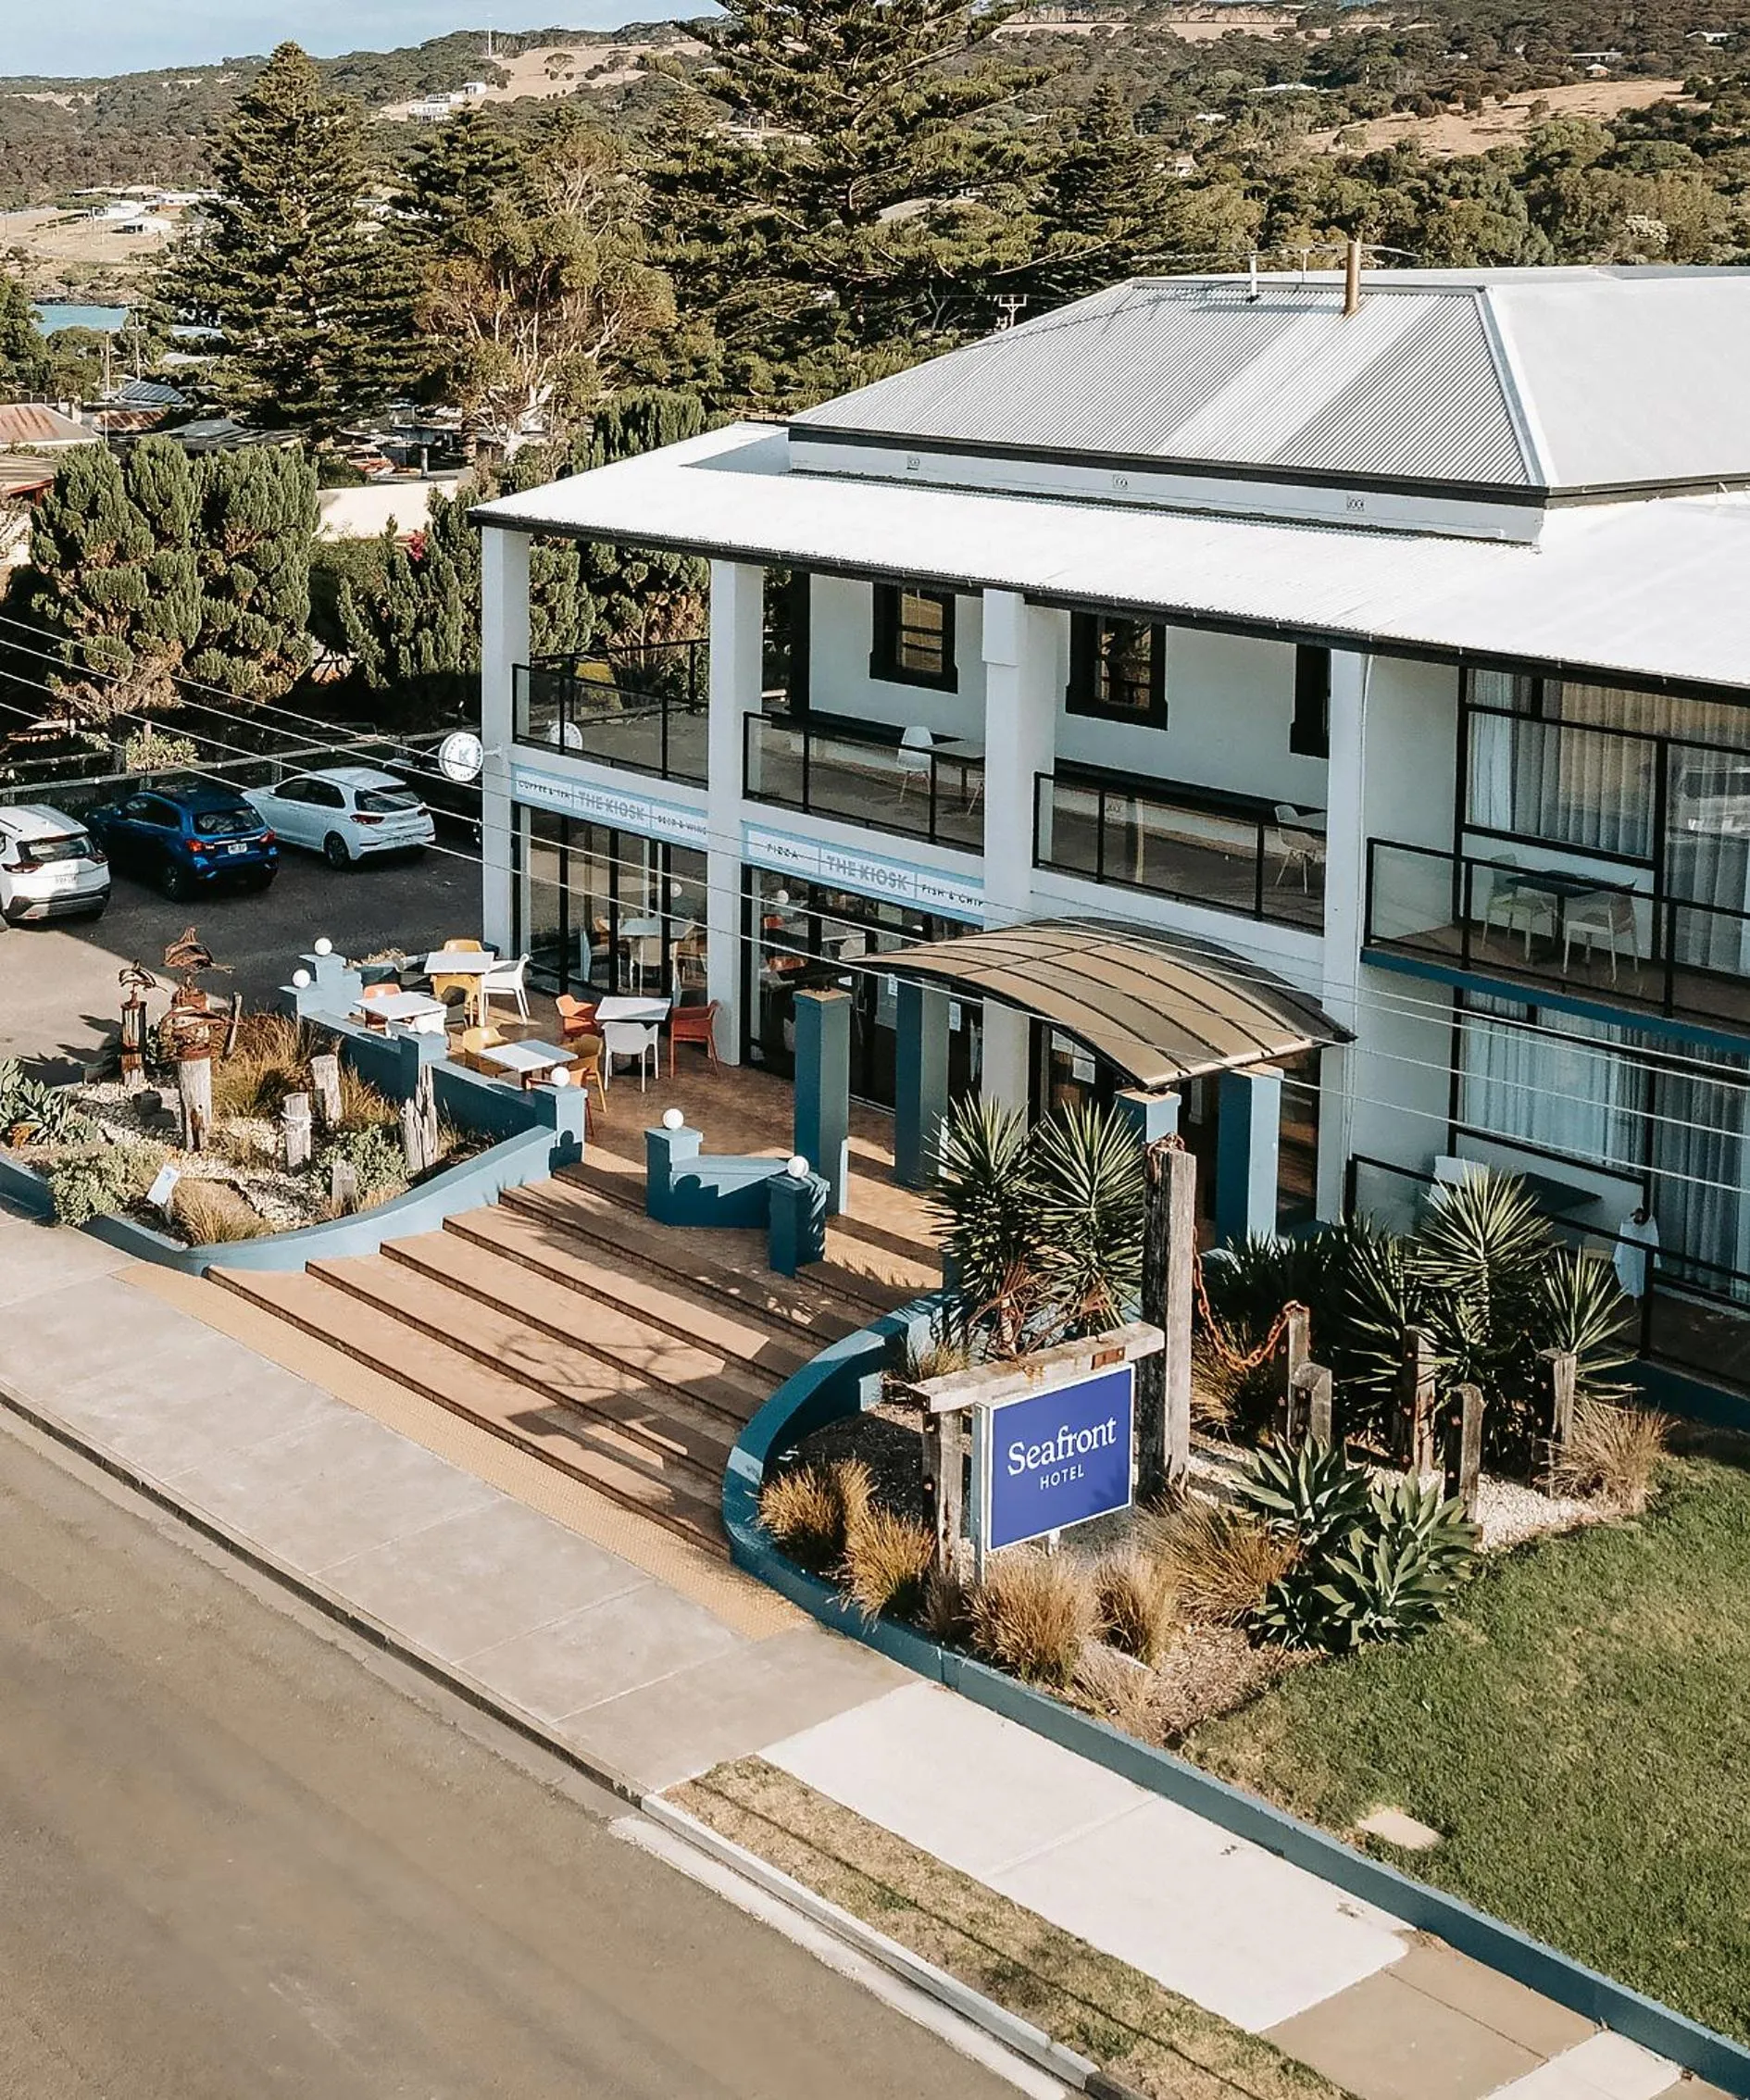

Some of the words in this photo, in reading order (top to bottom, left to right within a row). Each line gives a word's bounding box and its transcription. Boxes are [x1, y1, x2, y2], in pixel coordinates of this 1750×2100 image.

[579, 791, 603, 811] THE
[605, 799, 645, 822] KIOSK
[827, 854, 857, 878] THE
[859, 863, 908, 892] KIOSK
[1007, 1417, 1117, 1476] Seafront
[1040, 1464, 1084, 1490] HOTEL
